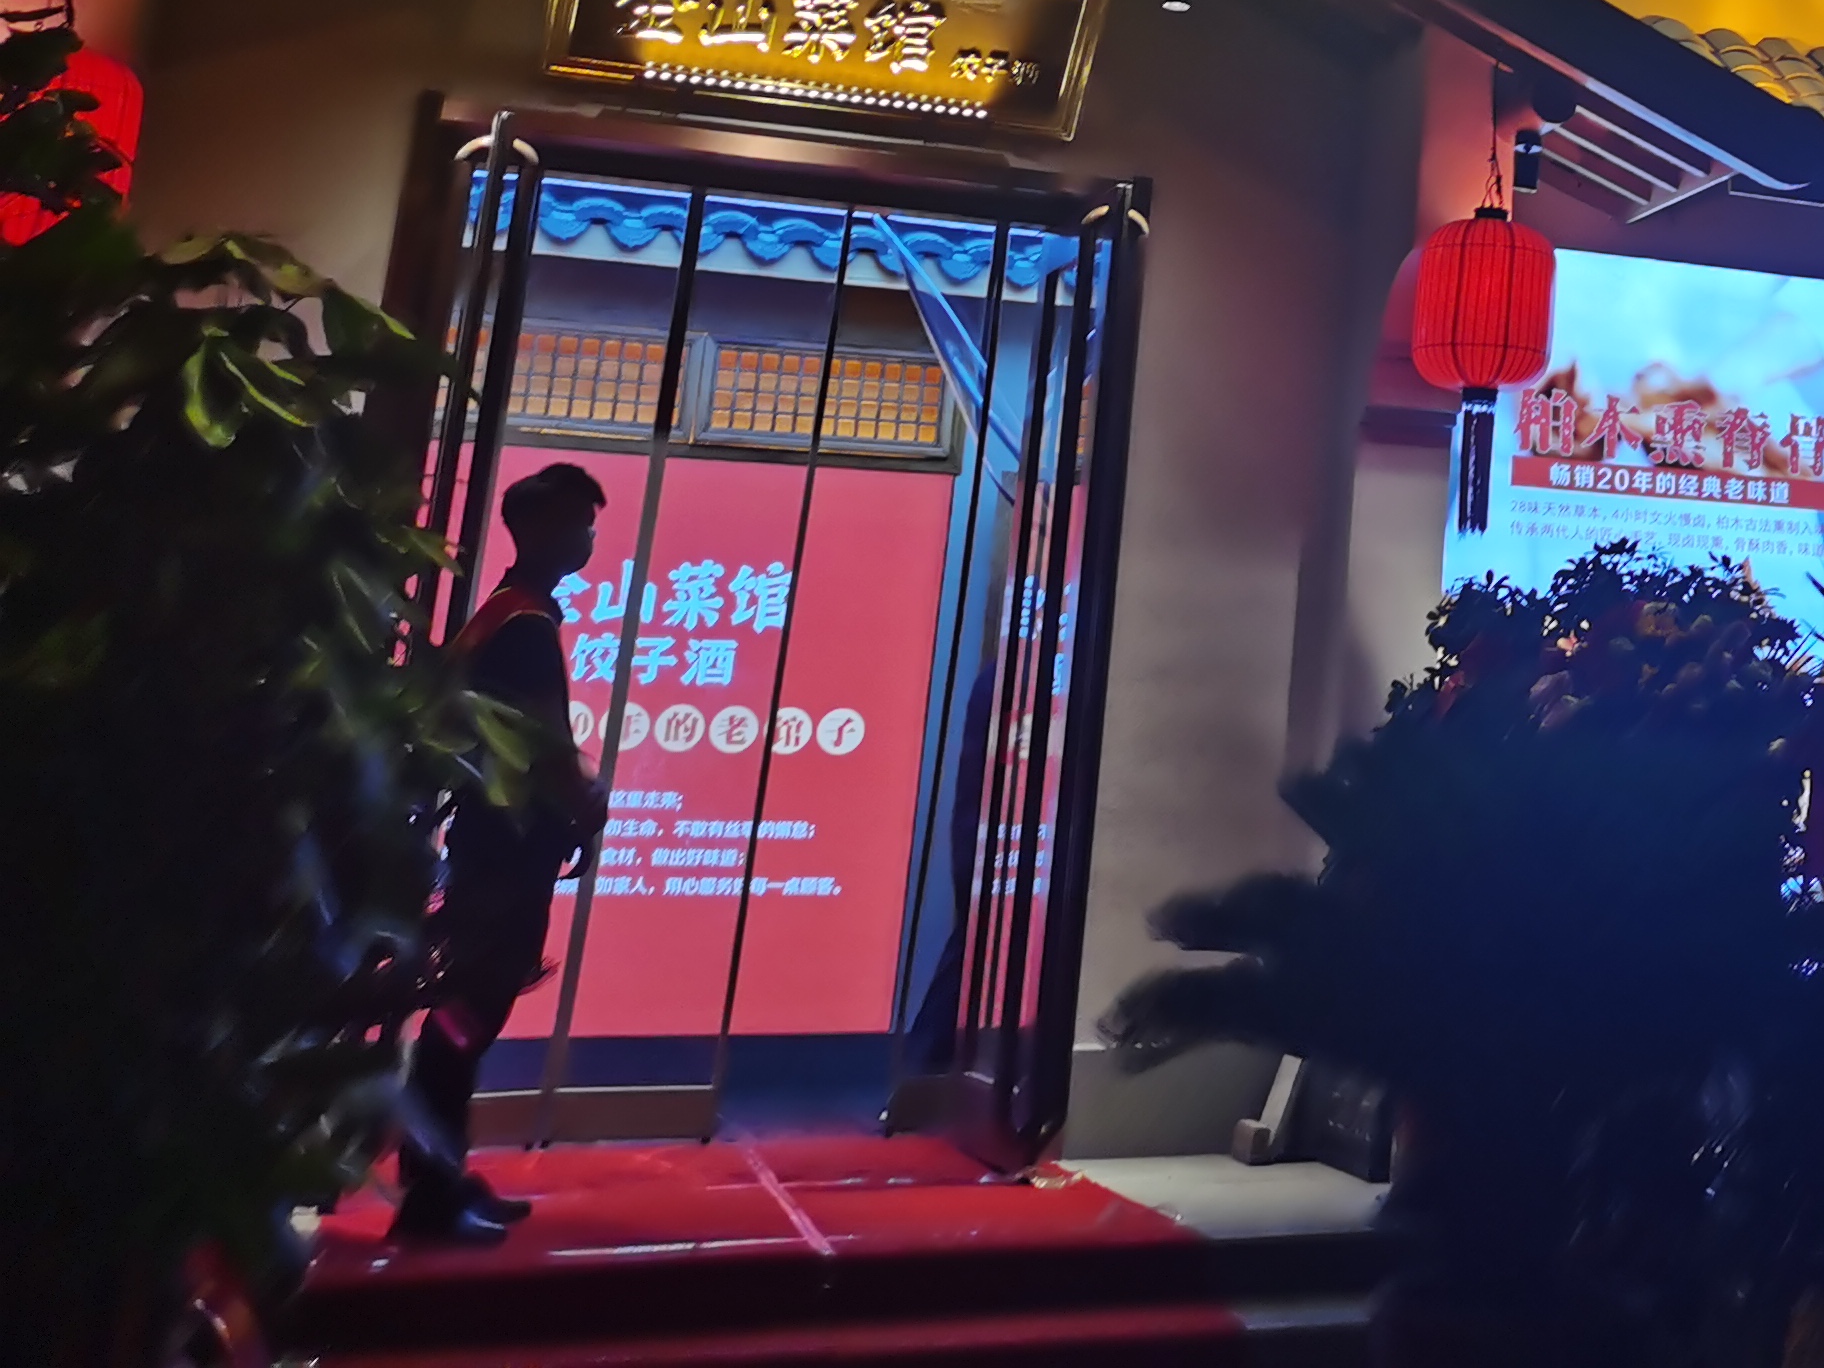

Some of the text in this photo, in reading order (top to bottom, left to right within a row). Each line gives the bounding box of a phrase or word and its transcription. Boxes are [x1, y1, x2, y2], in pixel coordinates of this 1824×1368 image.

[1548, 465, 1791, 506] 畅销20年的经典老味道
[570, 632, 740, 686] 饺子酒
